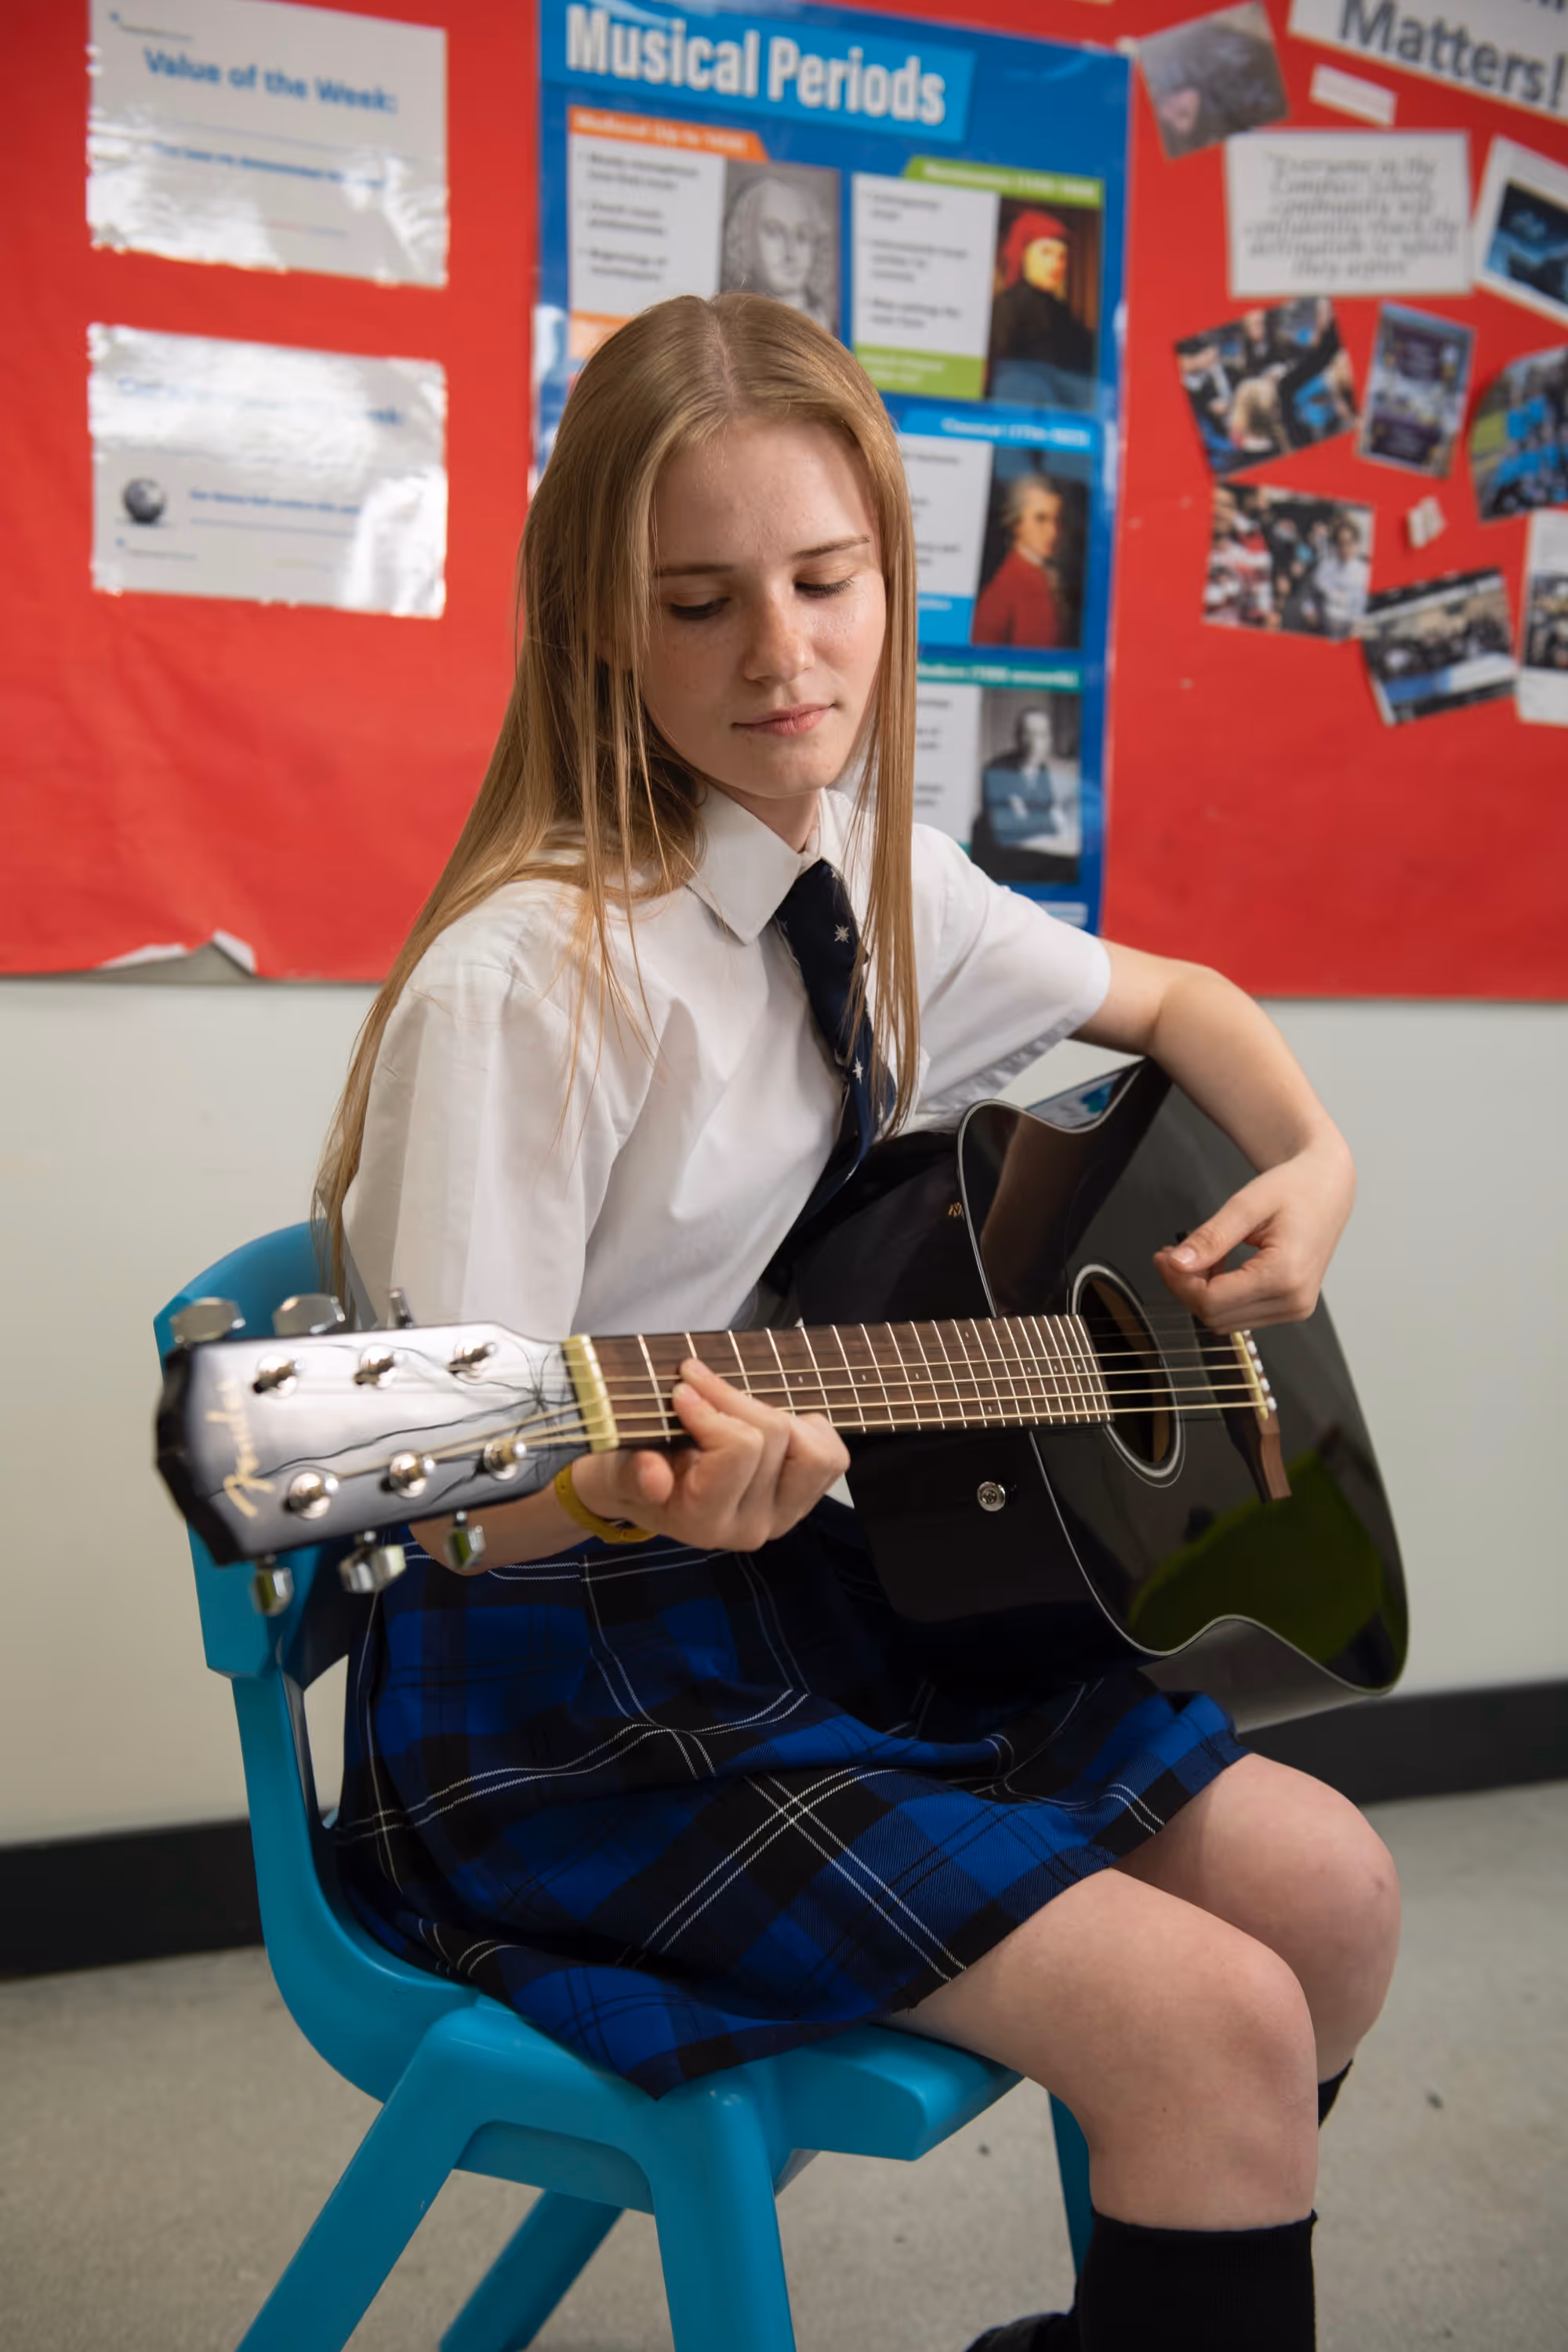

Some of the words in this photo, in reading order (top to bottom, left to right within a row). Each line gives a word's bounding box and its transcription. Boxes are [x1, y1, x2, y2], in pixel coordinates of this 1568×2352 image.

[143, 47, 221, 84] Value
[228, 64, 257, 89] of
[264, 68, 308, 100] the
[315, 77, 398, 114] Week:
[567, 4, 762, 98] Musical
[767, 36, 946, 126] Periods
[1339, 0, 1566, 109] Matters!
